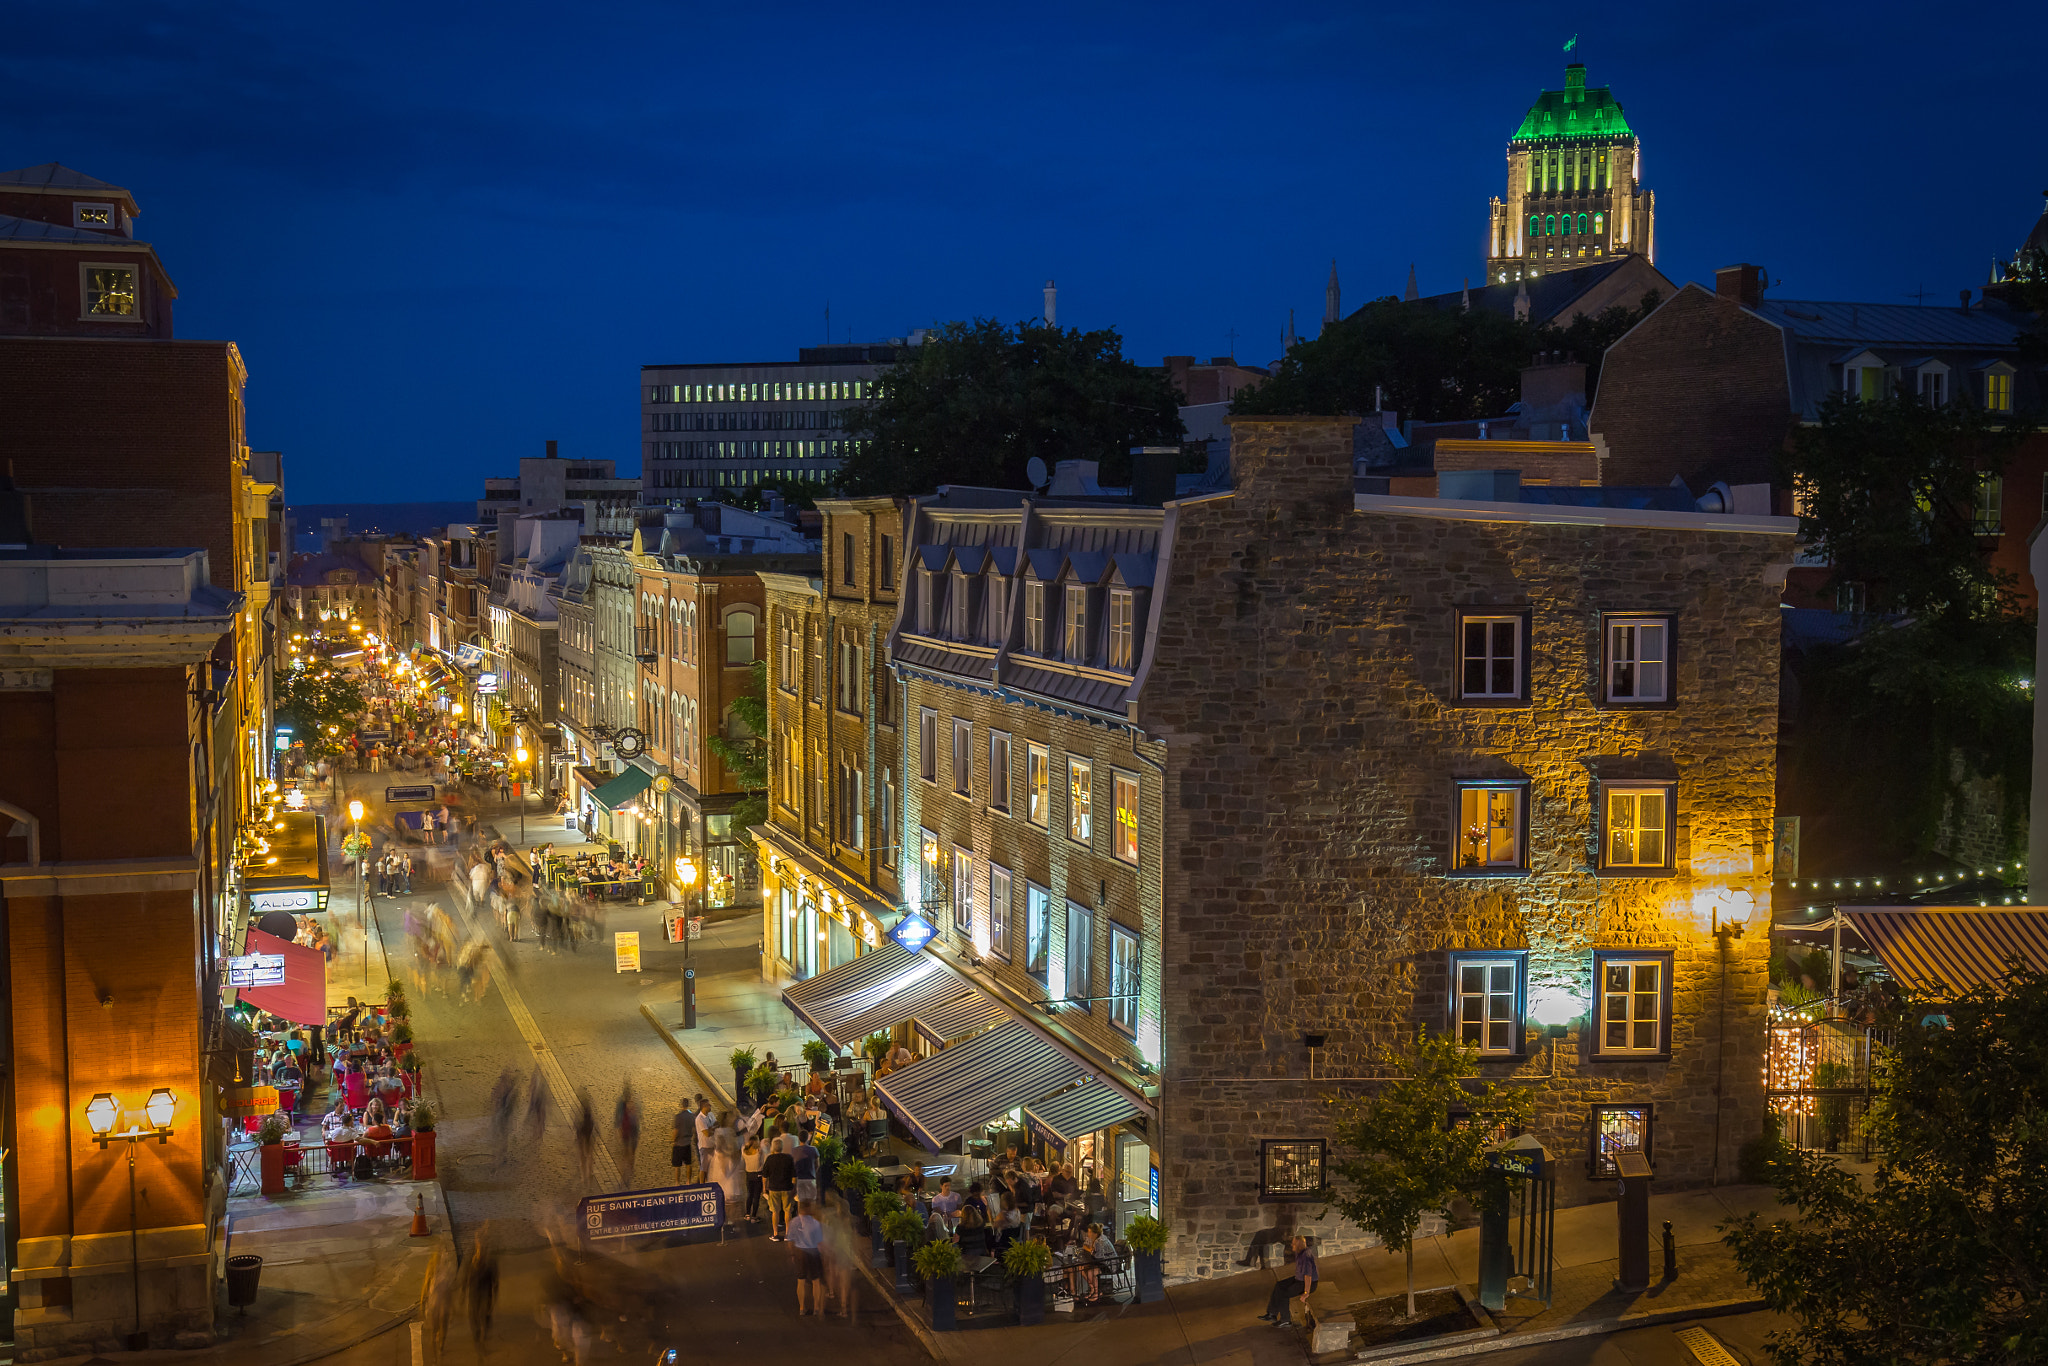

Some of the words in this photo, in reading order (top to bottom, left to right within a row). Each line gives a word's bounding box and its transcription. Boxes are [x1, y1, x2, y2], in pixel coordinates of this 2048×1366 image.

[260, 897, 308, 908] ALDO
[228, 1096, 277, 1107] OURDE
[586, 1203, 607, 1214] RUE
[609, 1197, 665, 1211] SAINT-JEAN
[668, 1191, 716, 1204] PIÉTONNE
[590, 1227, 612, 1236] ENTRE
[660, 1219, 679, 1228] CÔTE
[691, 1216, 715, 1224] PALAIS
